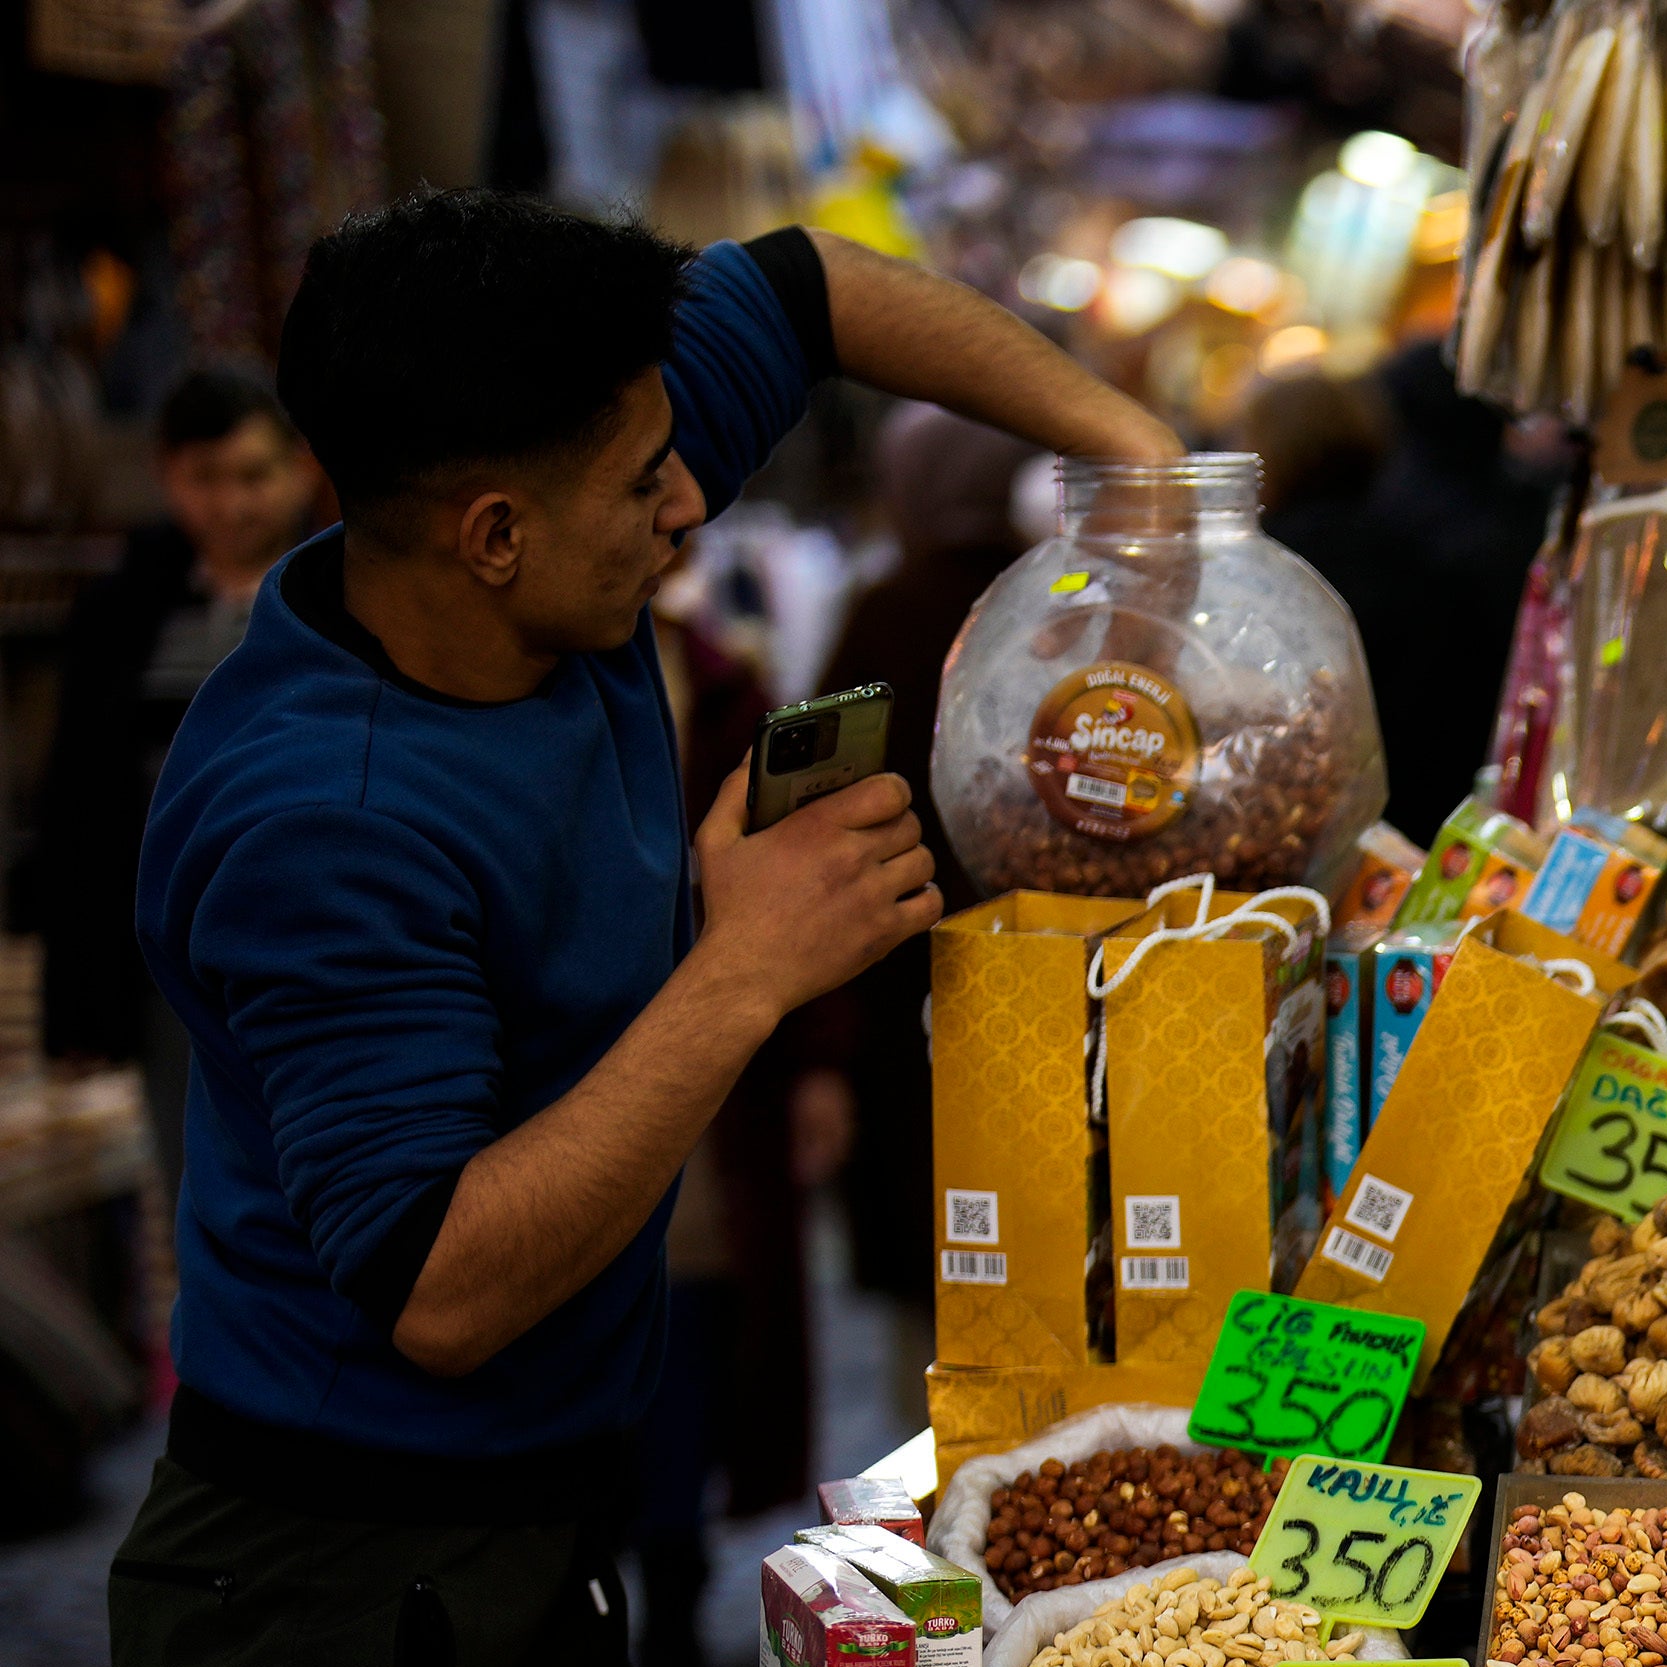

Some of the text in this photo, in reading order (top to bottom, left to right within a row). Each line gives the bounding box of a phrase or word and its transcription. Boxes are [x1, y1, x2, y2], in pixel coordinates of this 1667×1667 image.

[1069, 712, 1165, 759] Sincap
[1189, 1362, 1397, 1456] 350
[1266, 1518, 1428, 1613] 350
[781, 1619, 804, 1657] TURKO
[859, 1632, 889, 1643] TURKO
[928, 1617, 955, 1628] TURKO
